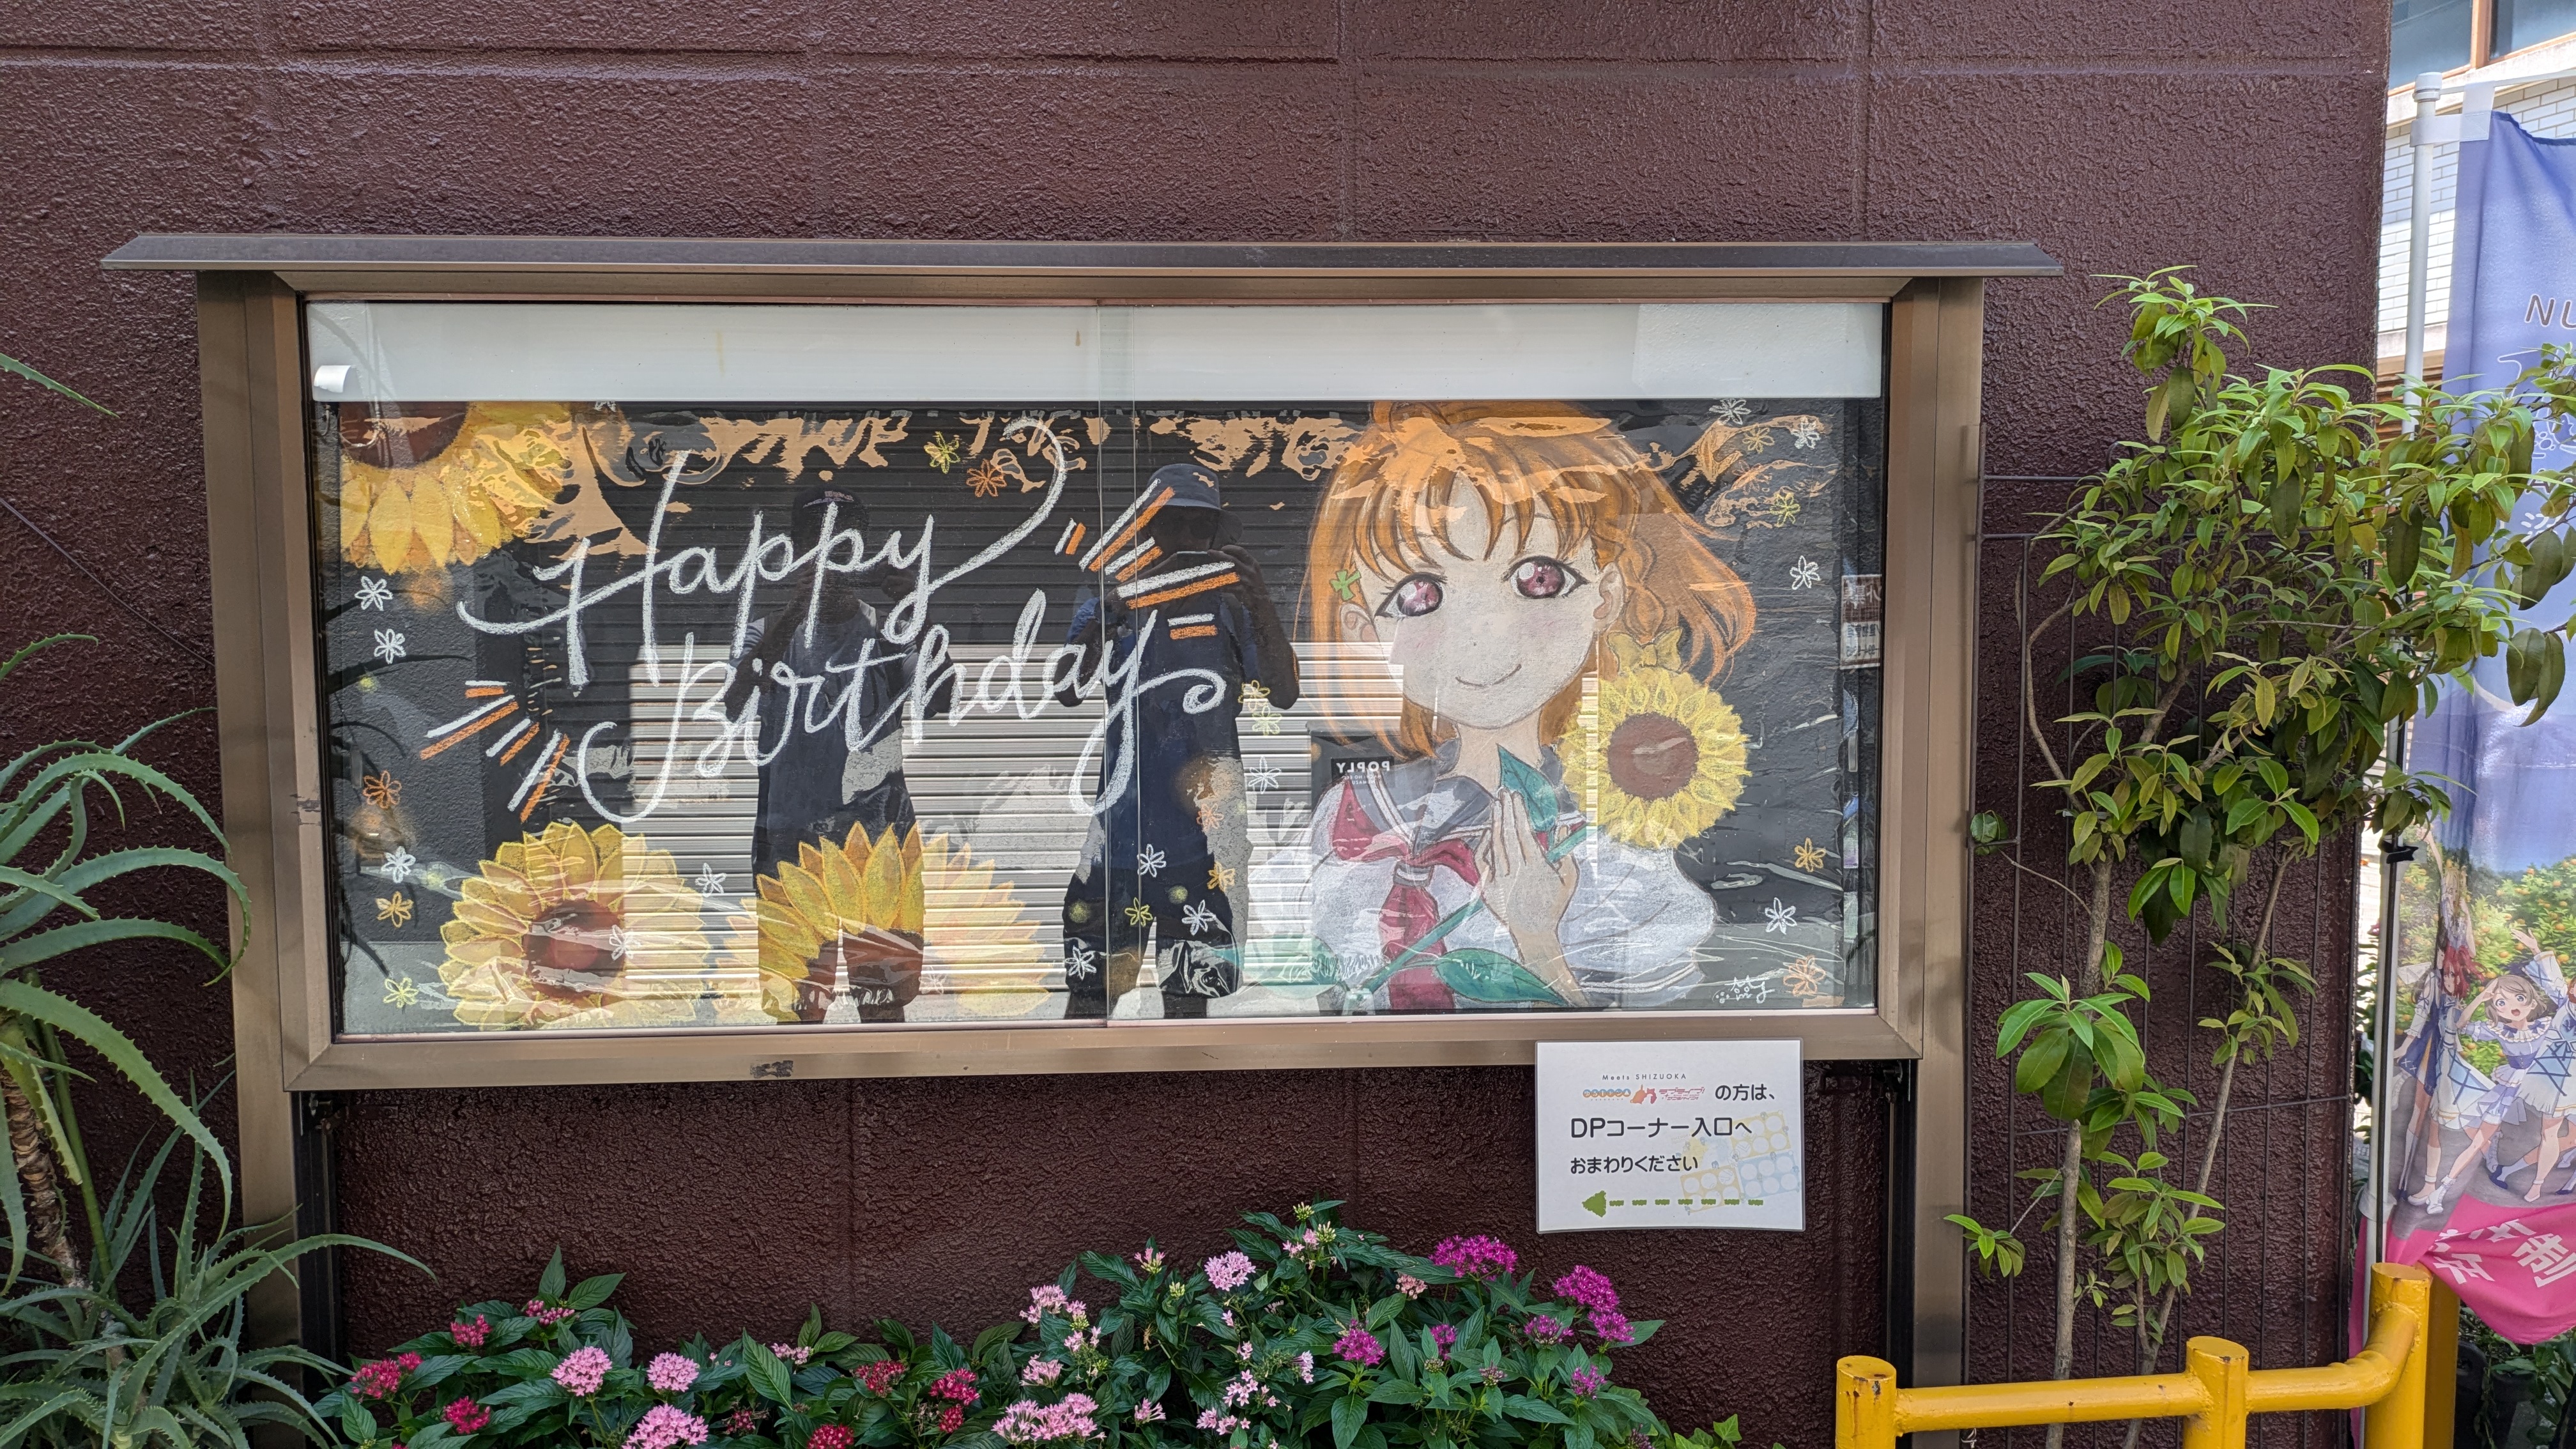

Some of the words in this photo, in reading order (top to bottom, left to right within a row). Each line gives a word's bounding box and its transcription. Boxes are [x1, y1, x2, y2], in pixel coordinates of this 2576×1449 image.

[456, 417, 1065, 687] Happy
[578, 588, 1227, 824] Birthday
[1715, 1084, 1775, 1101] の方は、
[1571, 1117, 1752, 1138] DPコーナー入口へ
[1570, 1155, 1698, 1174] おまわりください
